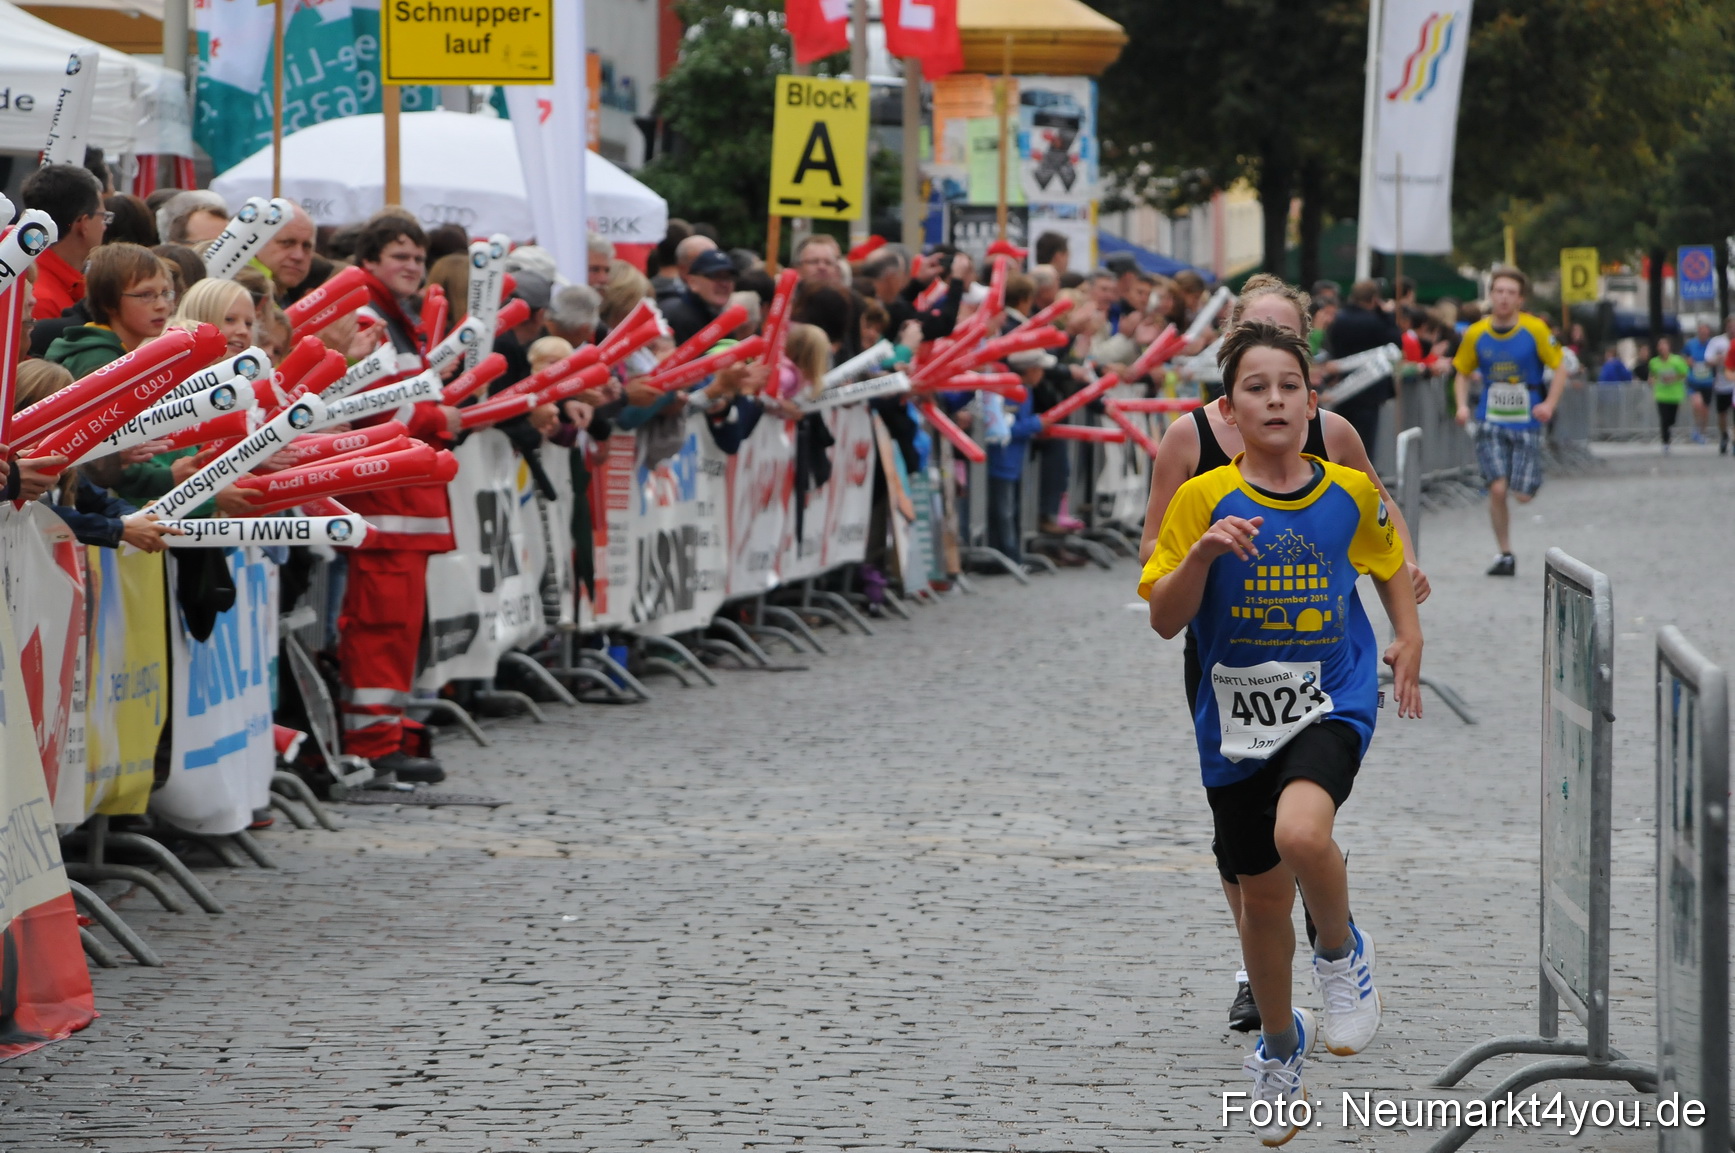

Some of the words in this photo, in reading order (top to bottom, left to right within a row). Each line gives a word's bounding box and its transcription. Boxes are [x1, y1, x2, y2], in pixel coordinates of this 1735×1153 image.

[395, 1, 541, 27] Schnupper-
[445, 33, 492, 54] lauf
[786, 83, 857, 109] Block
[792, 121, 842, 187] A
[87, 402, 125, 434] BKK
[268, 475, 305, 492] Audi
[307, 468, 341, 484] BKK
[252, 519, 310, 541] BMW
[1213, 673, 1248, 687] PARTL
[1231, 682, 1326, 727] 4023
